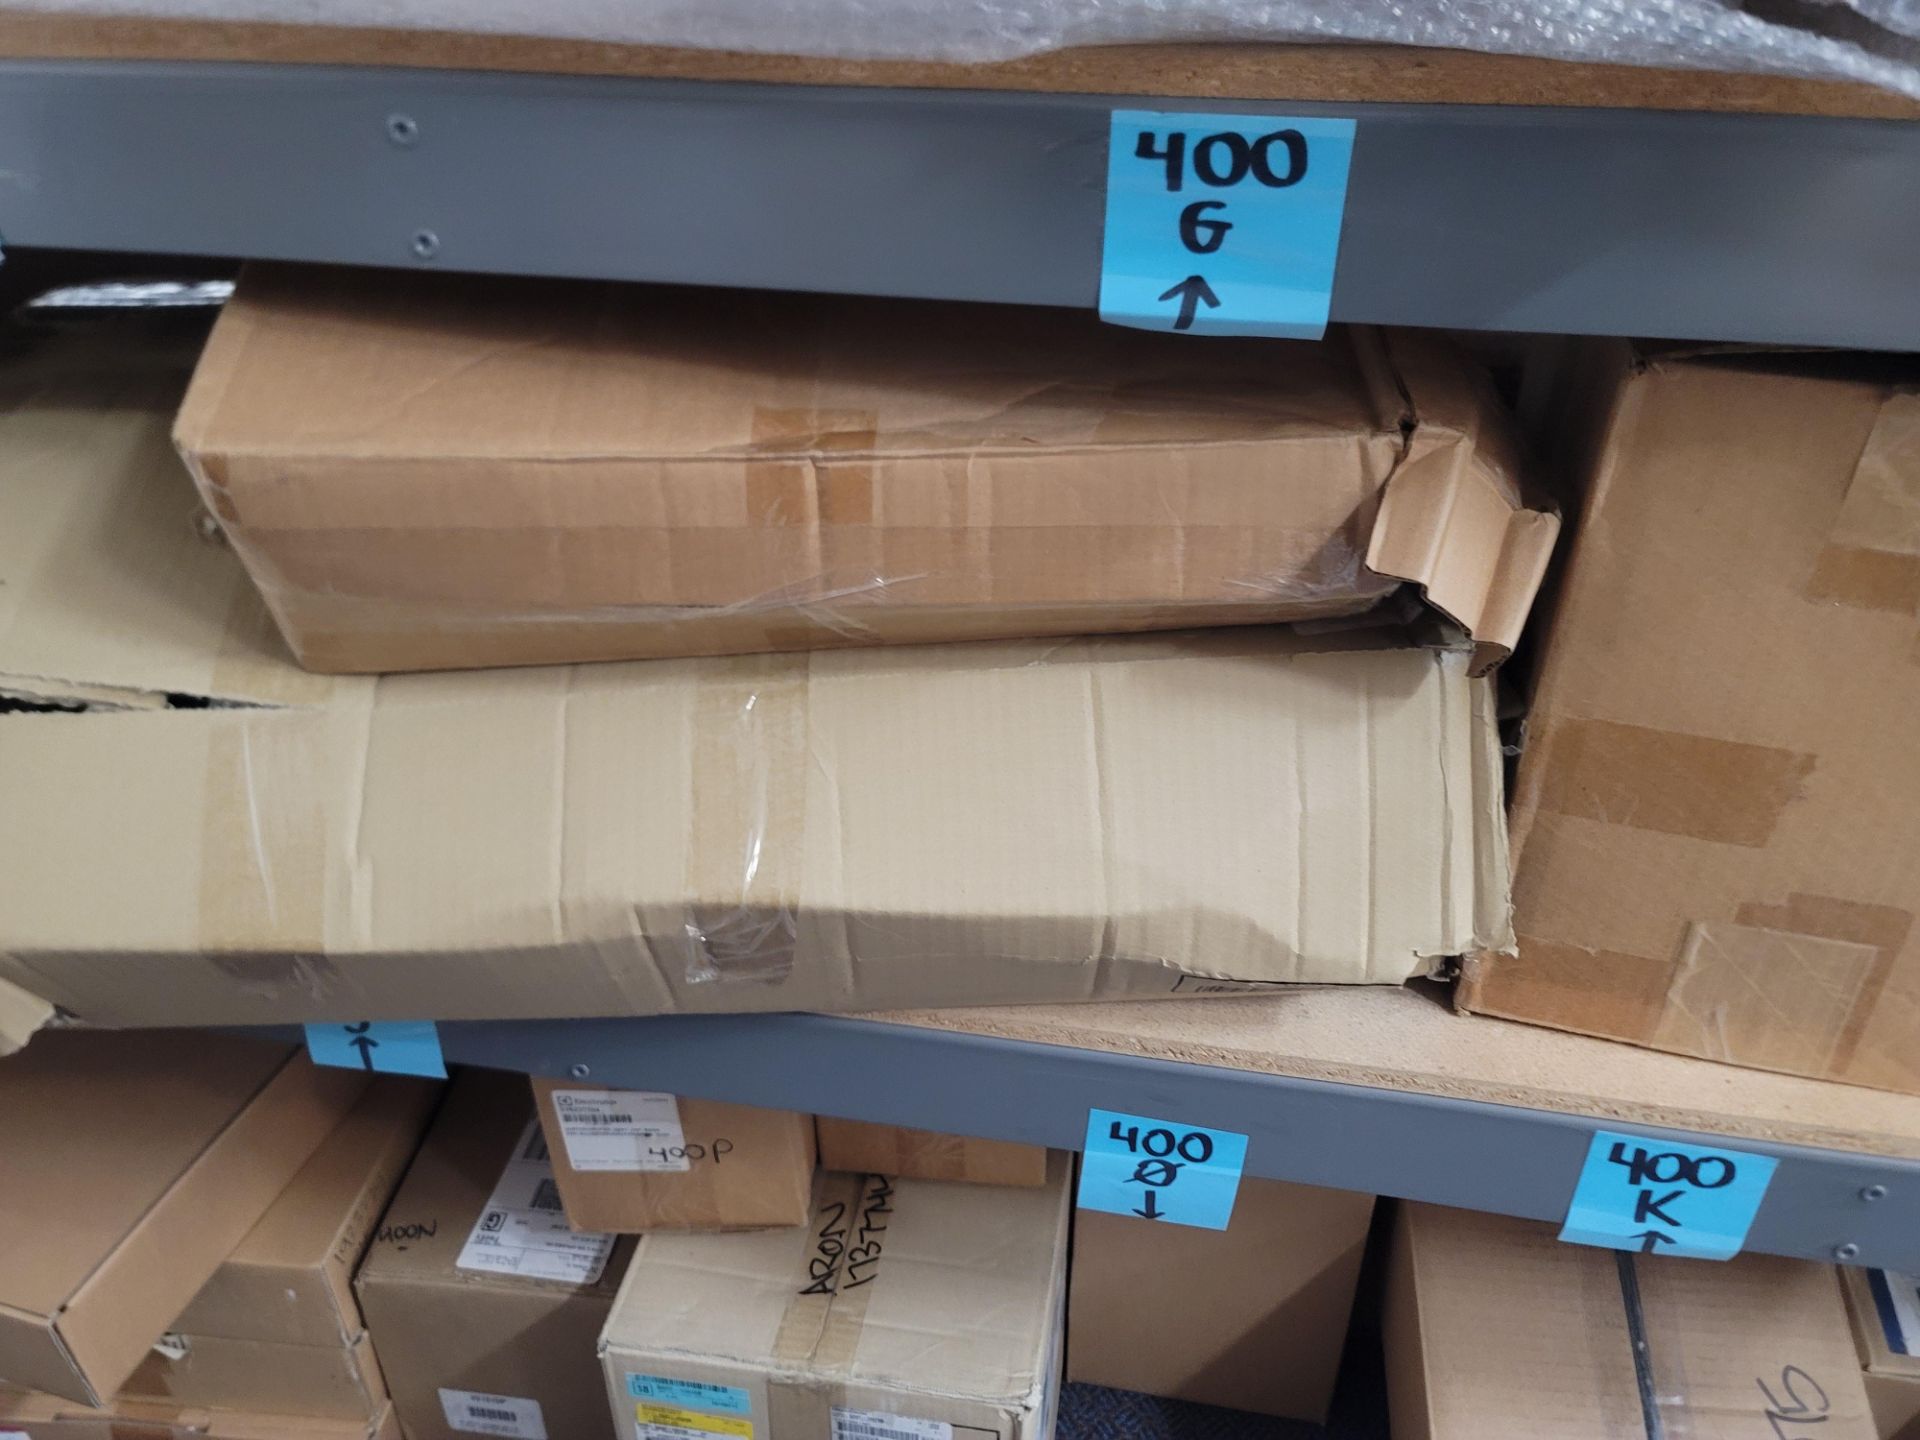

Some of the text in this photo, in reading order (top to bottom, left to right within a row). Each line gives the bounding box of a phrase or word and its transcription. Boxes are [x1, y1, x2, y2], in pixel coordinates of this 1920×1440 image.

[1135, 129, 1308, 192] 400
[1179, 201, 1233, 254] G
[1109, 1121, 1213, 1163] 400
[1608, 1142, 1736, 1188] 400
[1634, 1190, 1686, 1227] K
[798, 1200, 846, 1296] ARON
